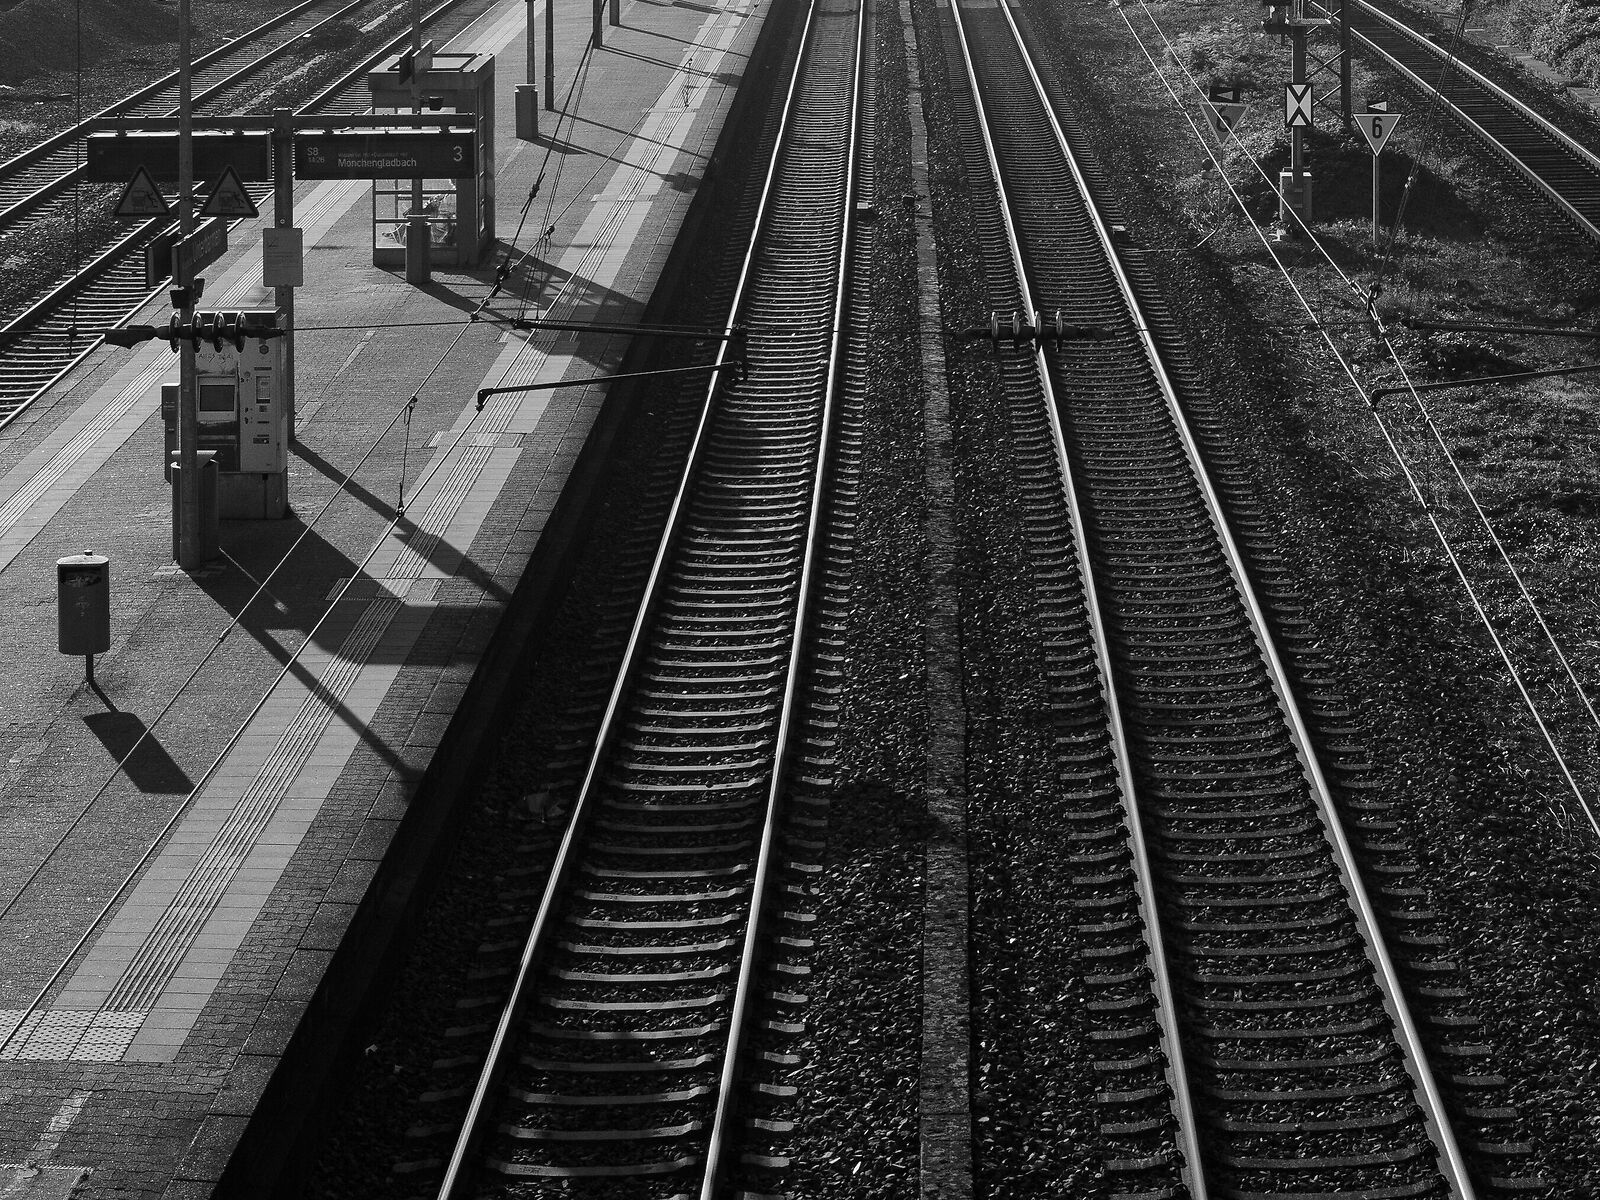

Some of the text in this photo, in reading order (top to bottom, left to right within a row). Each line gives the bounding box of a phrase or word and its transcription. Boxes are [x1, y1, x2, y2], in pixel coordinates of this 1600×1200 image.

[1215, 106, 1232, 132] 6
[1372, 116, 1383, 139] 6
[307, 147, 319, 156] S8
[452, 145, 463, 162] 3
